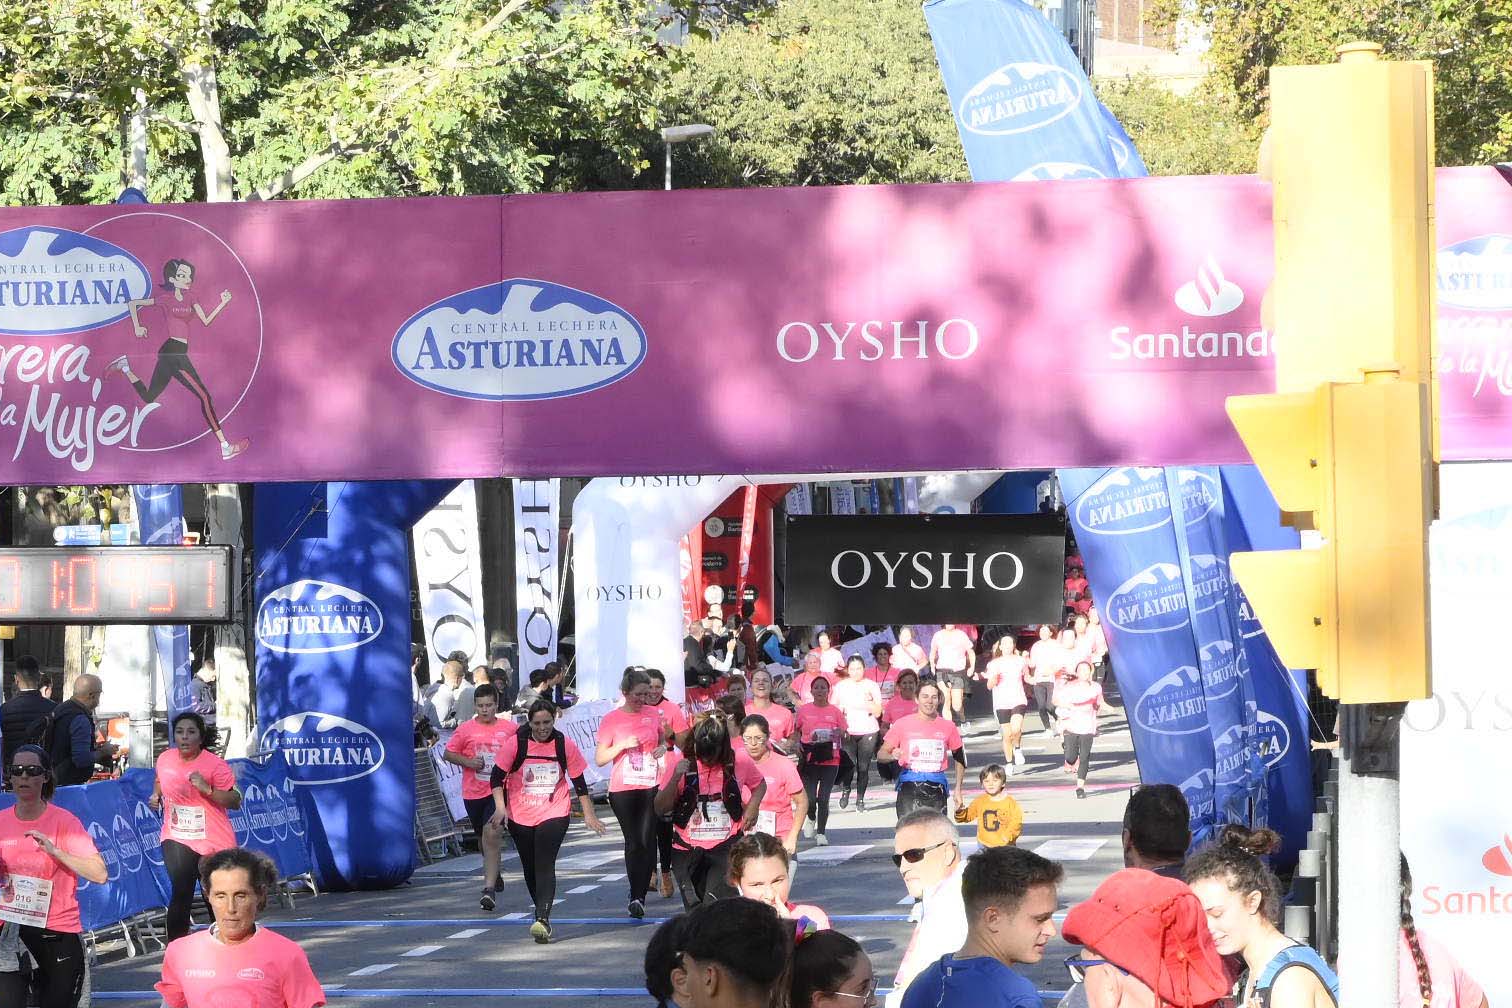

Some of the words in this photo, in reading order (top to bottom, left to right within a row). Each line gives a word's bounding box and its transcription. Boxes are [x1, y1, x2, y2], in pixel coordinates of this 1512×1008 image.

[54, 262, 127, 274] LECHERA
[451, 321, 529, 334] CENTRAL
[537, 319, 619, 332] LECHERA
[411, 326, 628, 370] ASTURIANA
[775, 319, 980, 362] OYSHO
[12, 377, 161, 472] Mujer
[830, 549, 1025, 590] OYSHO
[586, 584, 662, 602] OYSHO
[273, 604, 316, 614] CENTRAL
[320, 604, 369, 613] LECHERA
[260, 609, 374, 637] ASTURIANA
[321, 736, 370, 744] LECHERA
[281, 747, 375, 766] TURIANA
[981, 809, 1001, 832] G
[14, 893, 32, 903] 016
